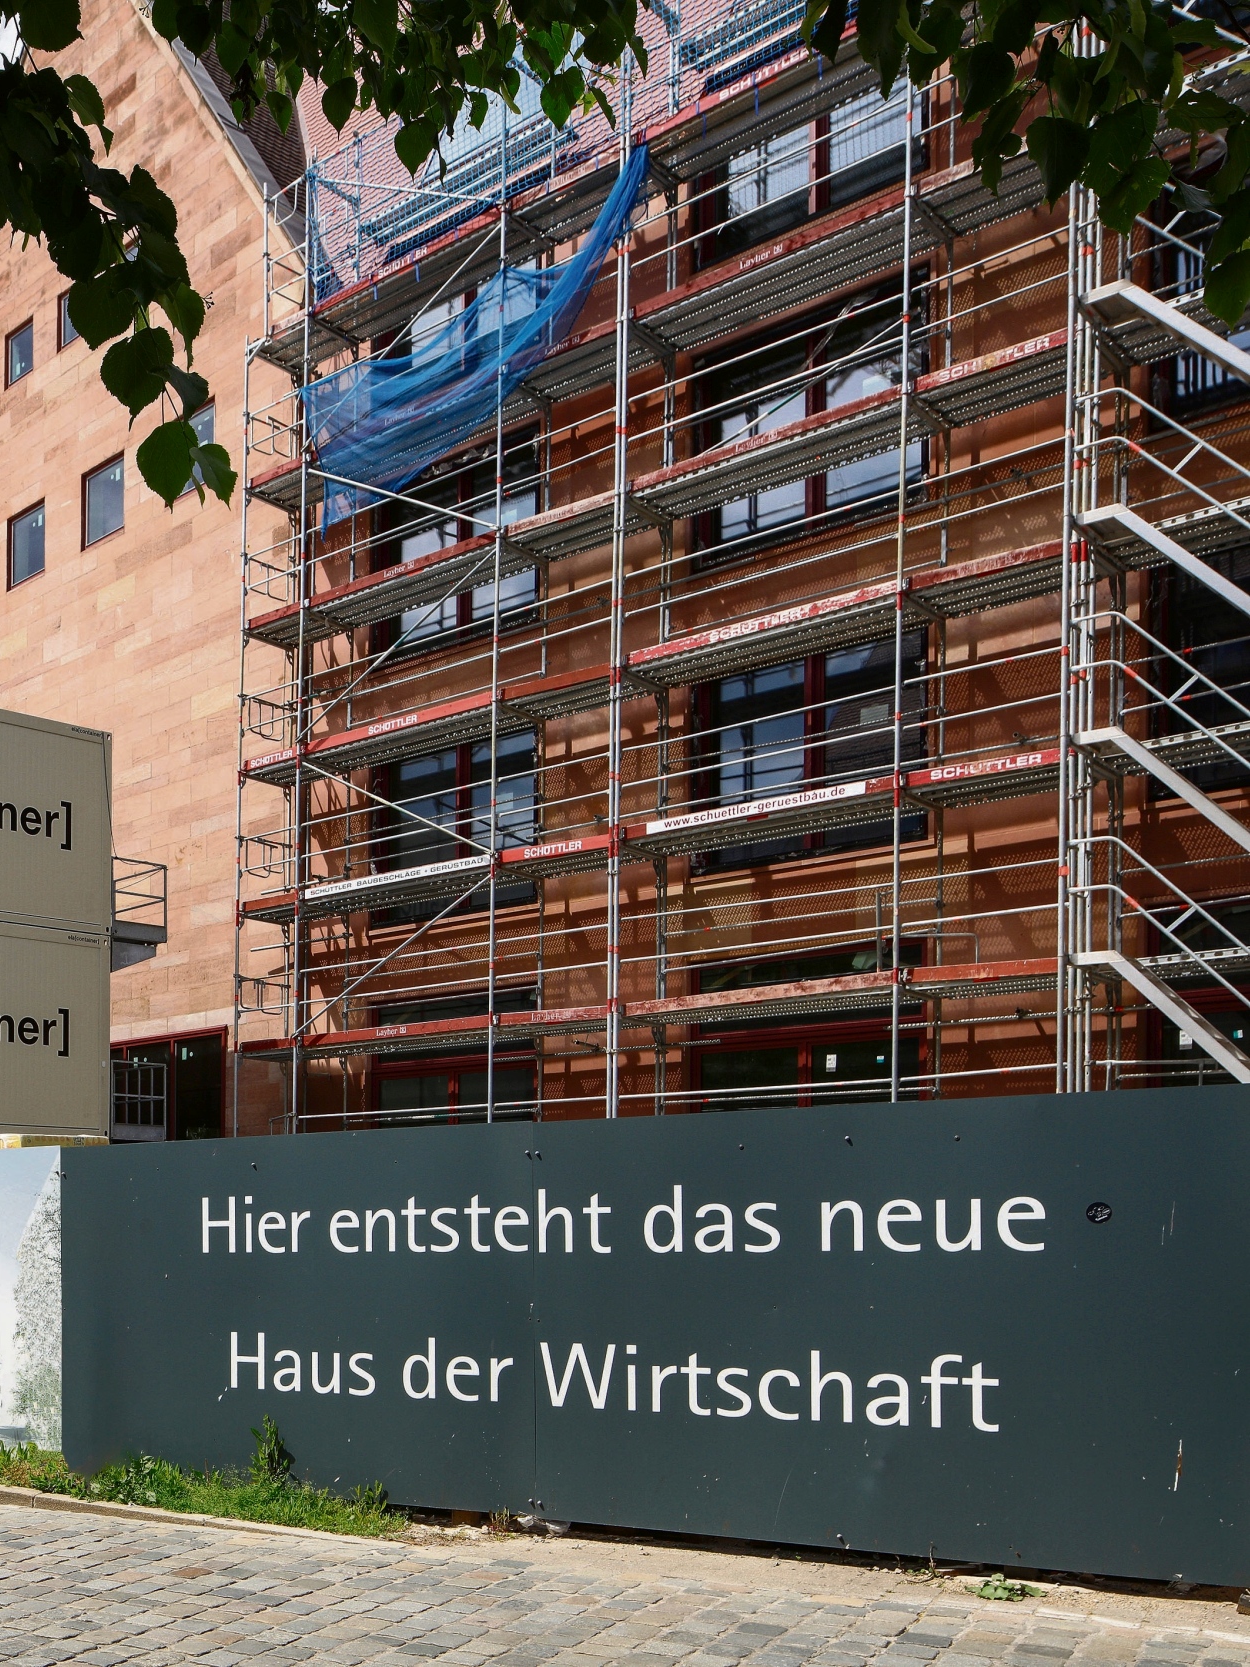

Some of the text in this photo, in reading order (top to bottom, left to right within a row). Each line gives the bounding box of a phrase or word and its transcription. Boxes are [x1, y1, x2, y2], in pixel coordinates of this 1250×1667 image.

[377, 247, 428, 279] SCHÜTTER
[938, 336, 1050, 382] SCHTTLER
[201, 1184, 1046, 1254] Hier entsteht das neue
[230, 1331, 1000, 1433] Haus der Wirtschaft
